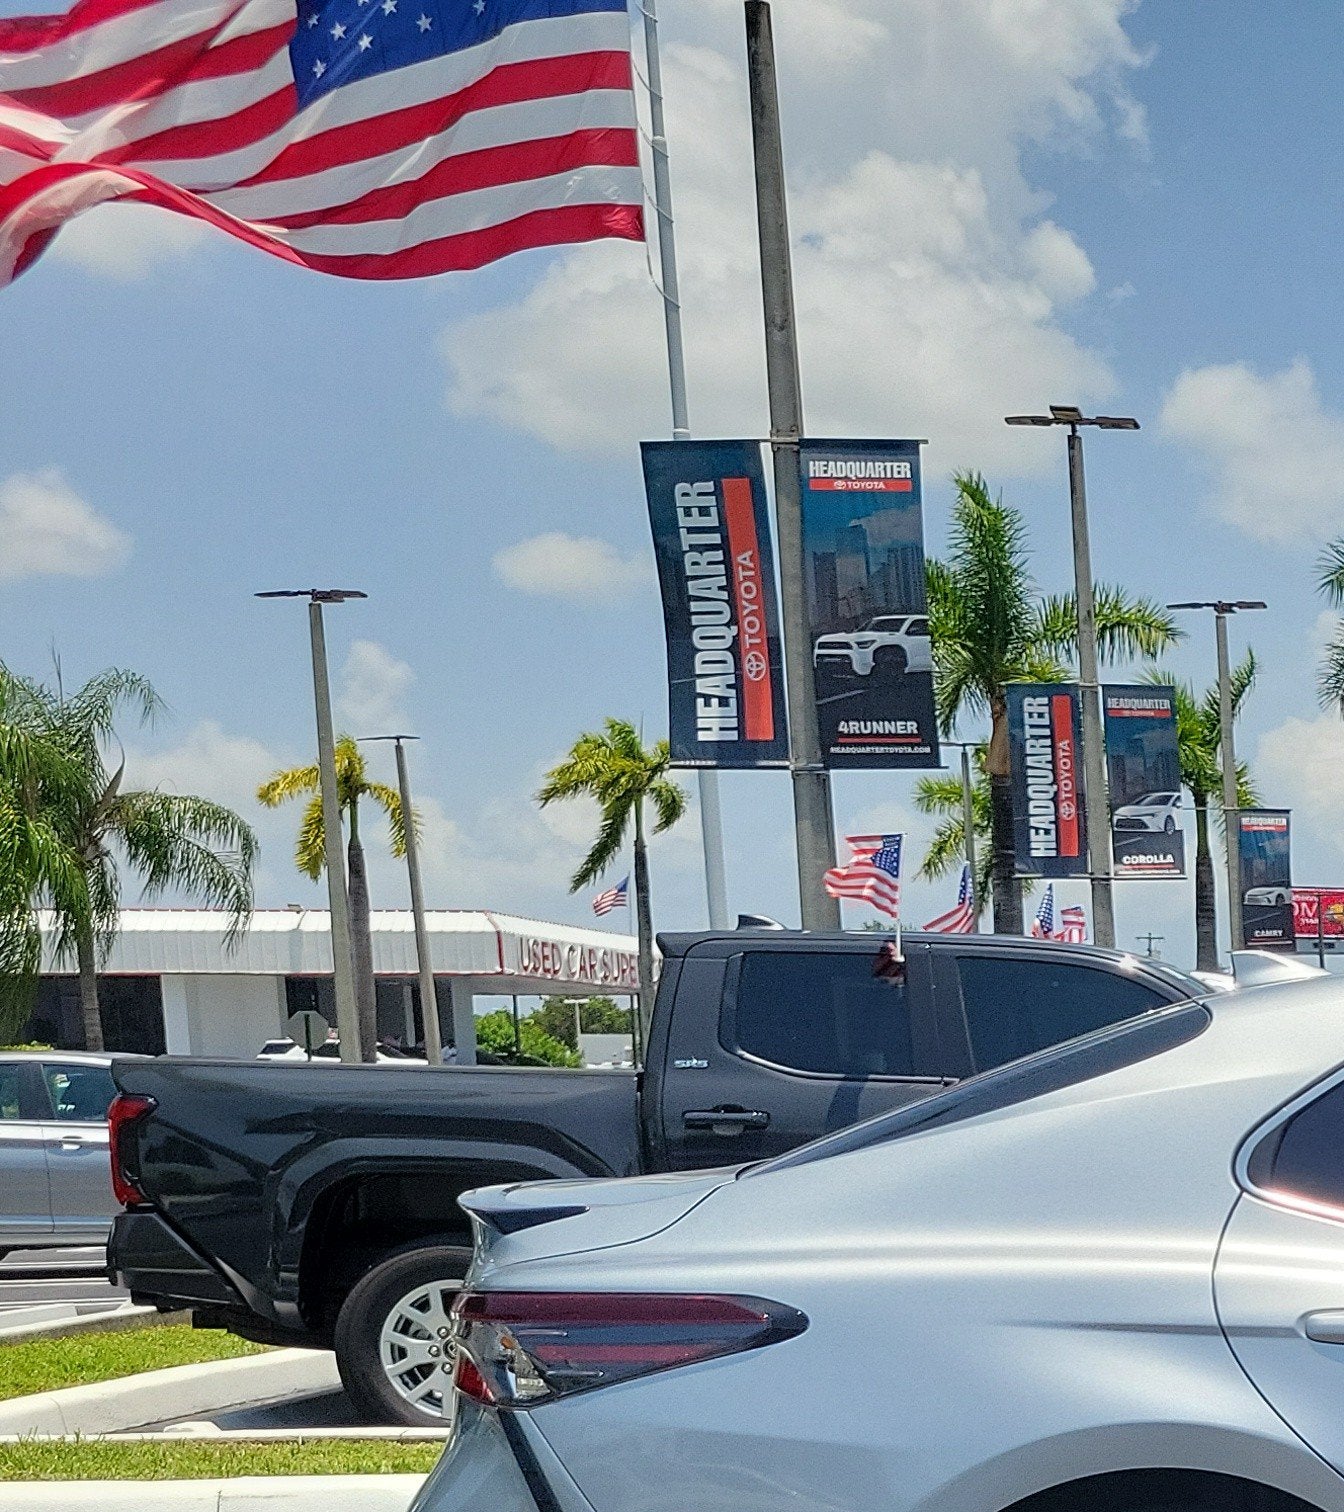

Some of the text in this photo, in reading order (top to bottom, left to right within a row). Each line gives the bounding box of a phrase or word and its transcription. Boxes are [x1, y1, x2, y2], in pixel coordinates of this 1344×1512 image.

[809, 461, 912, 479] HEADQUARTER
[847, 481, 886, 489] TOYOTA
[674, 480, 739, 741] HEADQUARTER
[737, 550, 763, 645] TOYOTA
[838, 720, 918, 734] 4RUNNER
[1024, 697, 1058, 858] HEADQUARTER
[1059, 739, 1074, 799] TOYOTA
[1122, 853, 1174, 864] COROLLA
[520, 937, 639, 987] USED CAR SUPE
